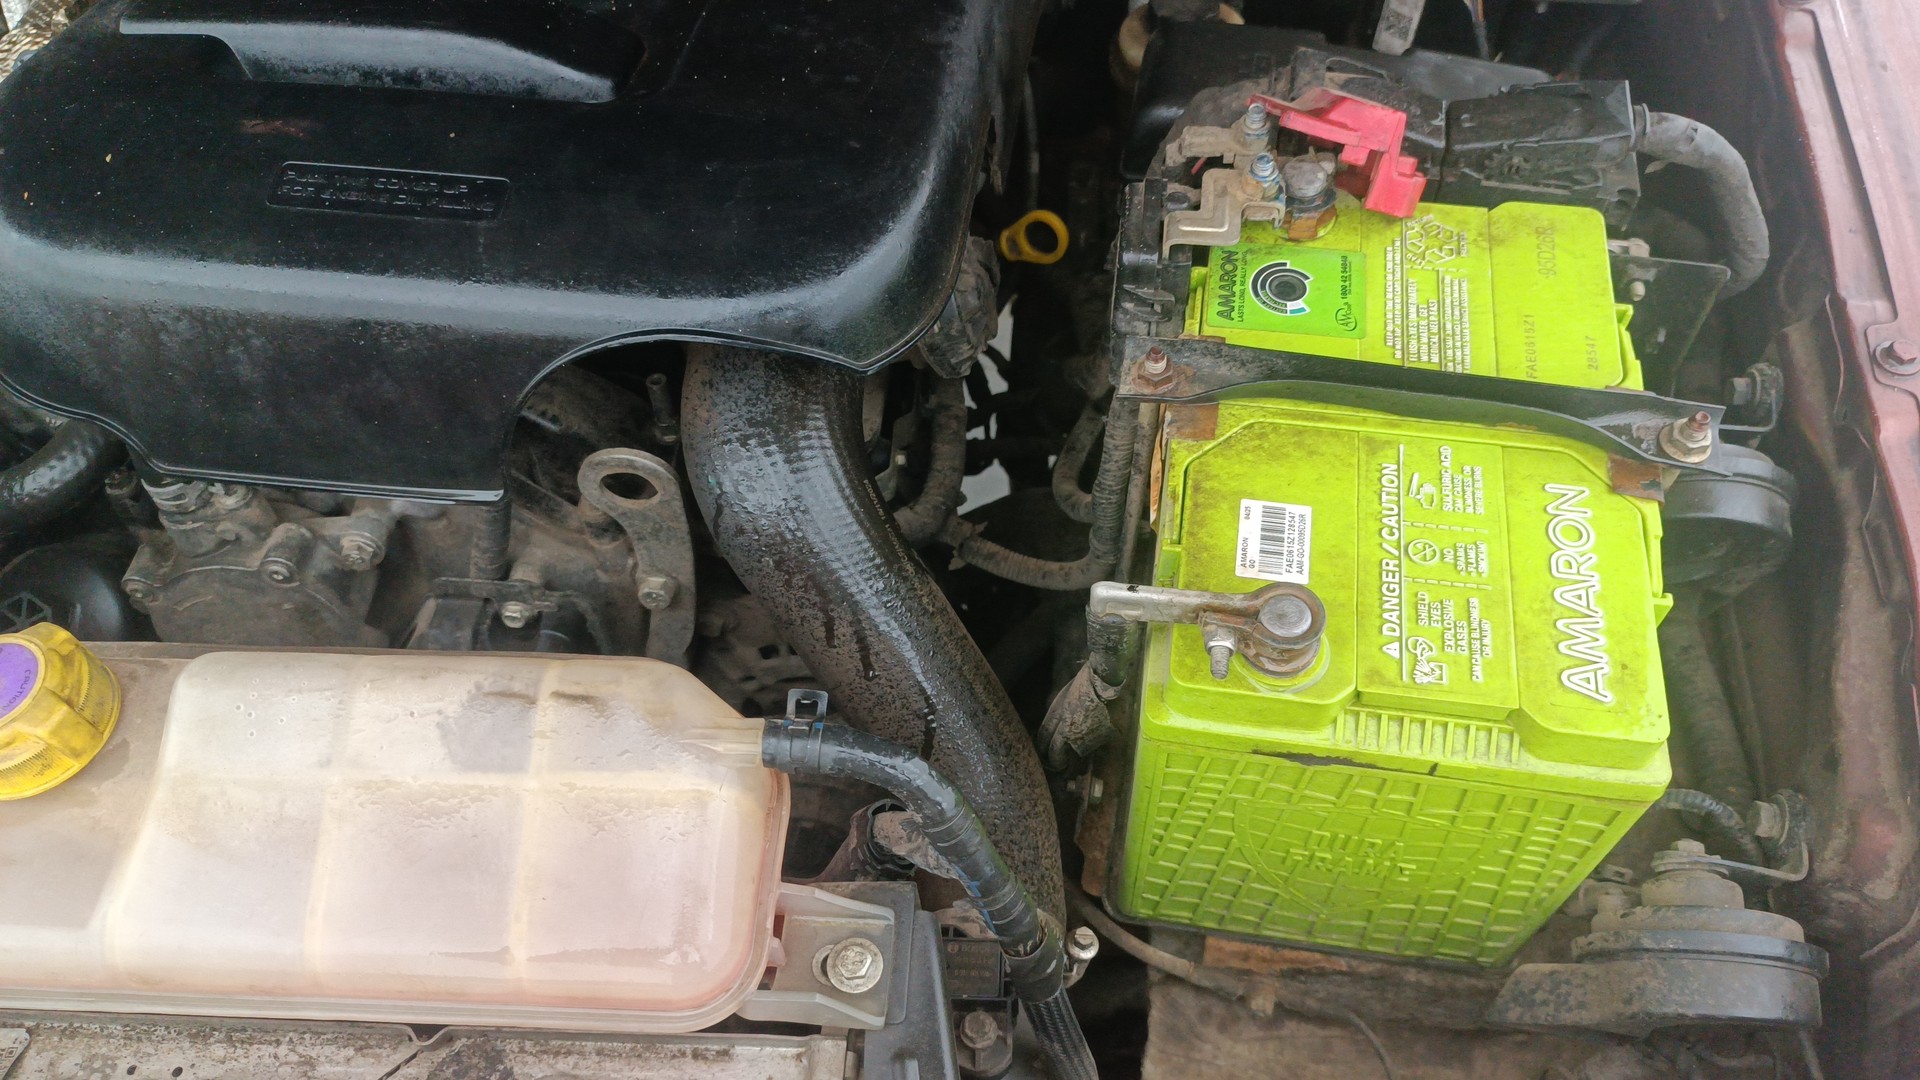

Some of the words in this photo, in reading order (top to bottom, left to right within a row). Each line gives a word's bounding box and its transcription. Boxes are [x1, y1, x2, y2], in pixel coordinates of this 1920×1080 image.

[1216, 250, 1239, 322] AMARON
[1239, 267, 1247, 286] REALLY
[1340, 284, 1348, 300] 1800
[1407, 278, 1418, 320] IMMEDIATELY
[1237, 305, 1245, 322] LASTS
[1419, 303, 1428, 317] GET
[1429, 298, 1438, 314] FAST
[1408, 321, 1418, 338] EYES
[1430, 315, 1440, 333] HELP
[1408, 339, 1418, 362] FLUSH
[1420, 344, 1429, 362] WITH
[1430, 334, 1440, 364] MEDICAL
[1585, 335, 1599, 370] 28547
[1440, 445, 1453, 468] ACID
[1463, 464, 1472, 476] OR
[1442, 468, 1454, 511] SULFURIC
[1454, 474, 1463, 496] CAUSE
[1474, 466, 1484, 488] BURNS
[1455, 498, 1464, 512] CAN
[1464, 477, 1474, 514] BLINDNESS
[1475, 490, 1485, 516] SEVERE
[1240, 536, 1249, 569] AMARON
[1285, 511, 1296, 573] FAE0615Z128547
[1443, 547, 1455, 563] NO
[1248, 558, 1256, 569] GO
[1456, 542, 1466, 572] SPARKS
[1467, 543, 1477, 572] FLAMES
[1478, 541, 1488, 574] SMOKING
[1544, 483, 1613, 704] AMARON
[1418, 591, 1429, 626] SHIELD
[1430, 601, 1442, 628] EYES
[1469, 597, 1480, 638] BLINDNESS
[1443, 598, 1456, 652] EXPLOSIVE
[1456, 620, 1468, 654] GASES
[1480, 619, 1492, 646] INJURY
[1471, 638, 1481, 664] CAUSE
[1482, 646, 1493, 657] OR
[1472, 665, 1483, 681] CAN
[2, 669, 32, 712] CAUTION
[1306, 829, 1404, 858] DURA
[1283, 848, 1416, 881] FRAME
